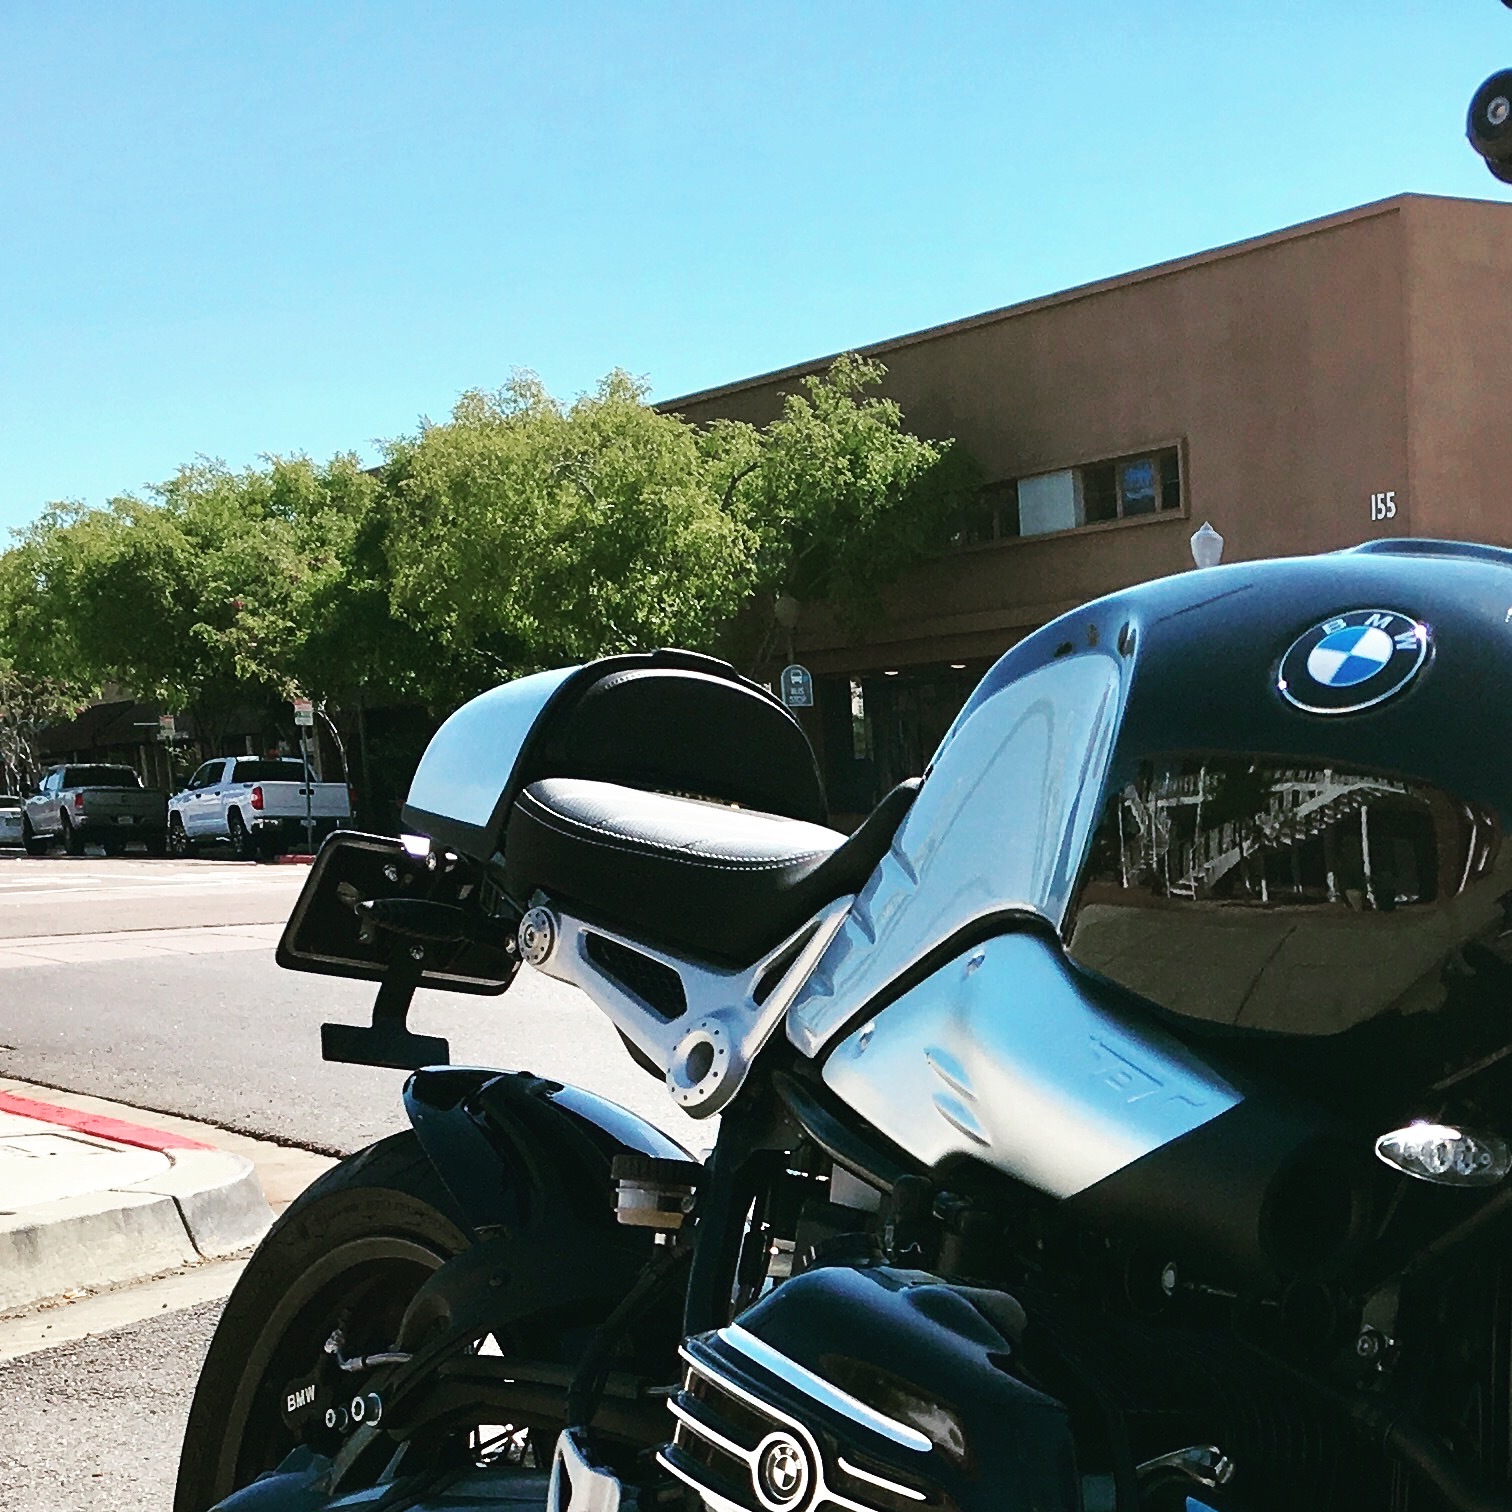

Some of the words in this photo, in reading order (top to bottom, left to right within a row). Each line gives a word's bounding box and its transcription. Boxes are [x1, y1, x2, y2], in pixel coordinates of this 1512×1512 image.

[1371, 491, 1397, 521] 155
[1322, 613, 1417, 650] BMW
[287, 1384, 316, 1412] BMW
